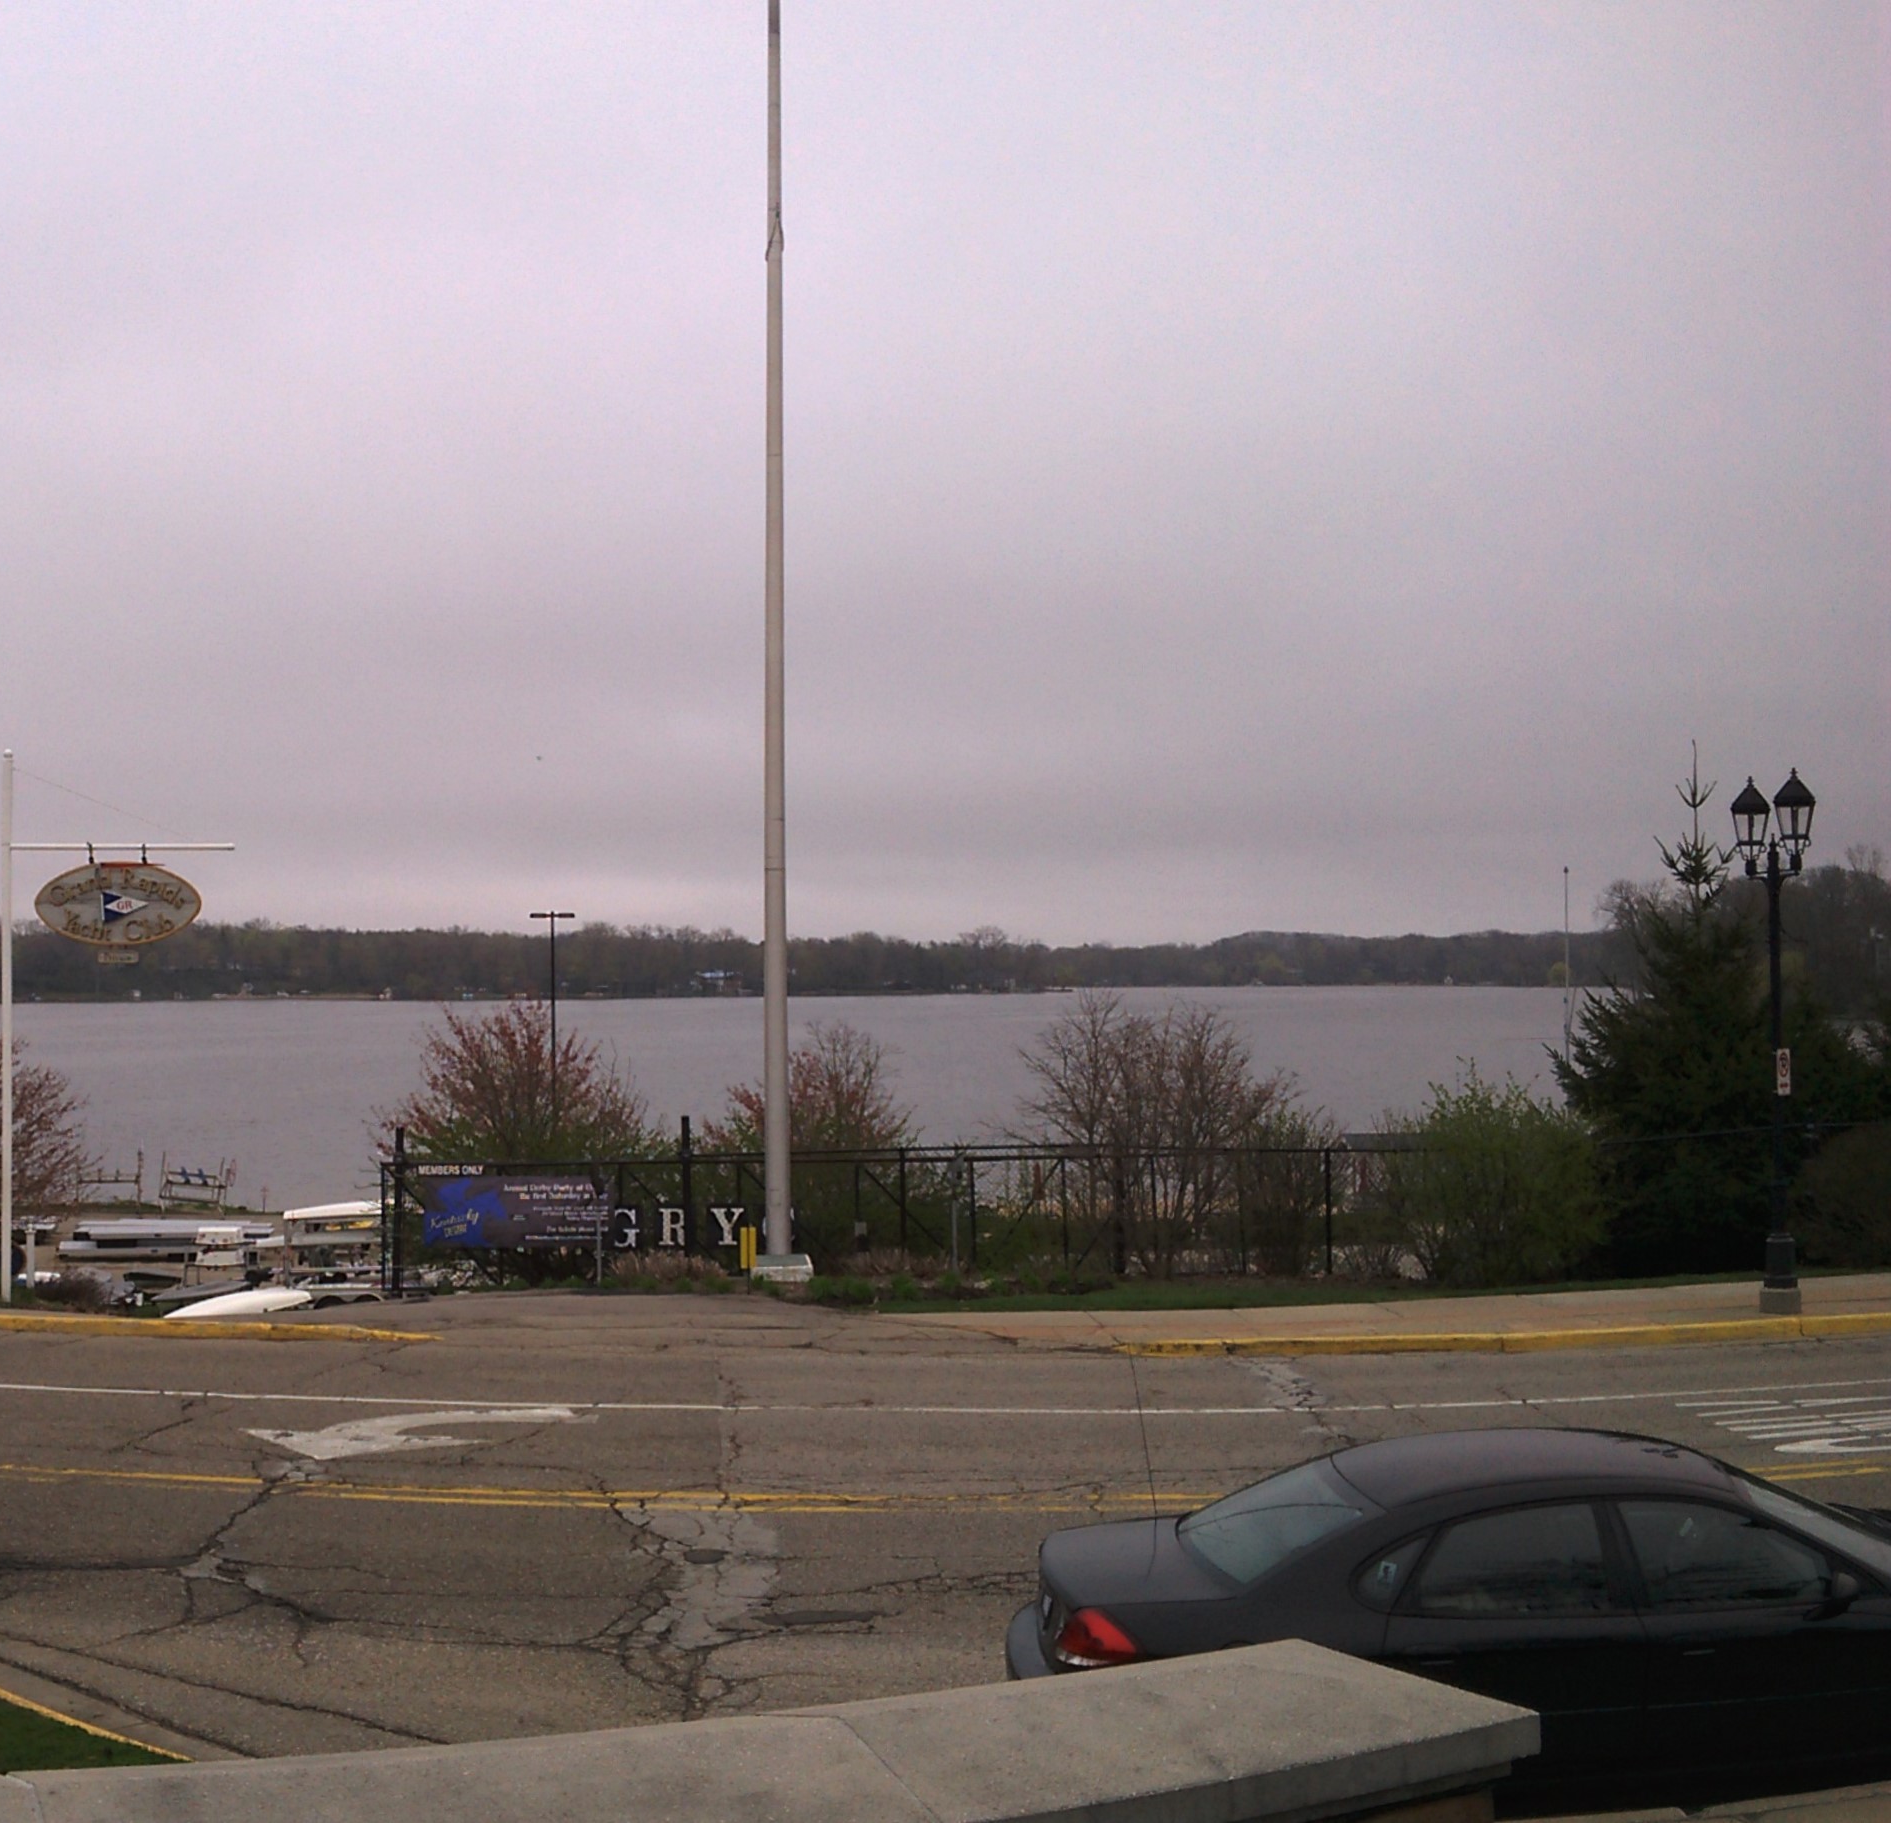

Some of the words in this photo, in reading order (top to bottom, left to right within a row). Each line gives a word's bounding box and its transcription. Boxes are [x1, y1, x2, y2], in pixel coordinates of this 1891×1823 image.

[49, 867, 112, 906] Grand
[121, 867, 185, 910] Rapids
[116, 900, 132, 910] GR
[62, 909, 111, 941] Yacht
[123, 913, 174, 941] Club
[418, 1165, 460, 1175] MEMBERS
[462, 1165, 484, 1175] ONLY
[430, 1208, 479, 1229] Kentucky
